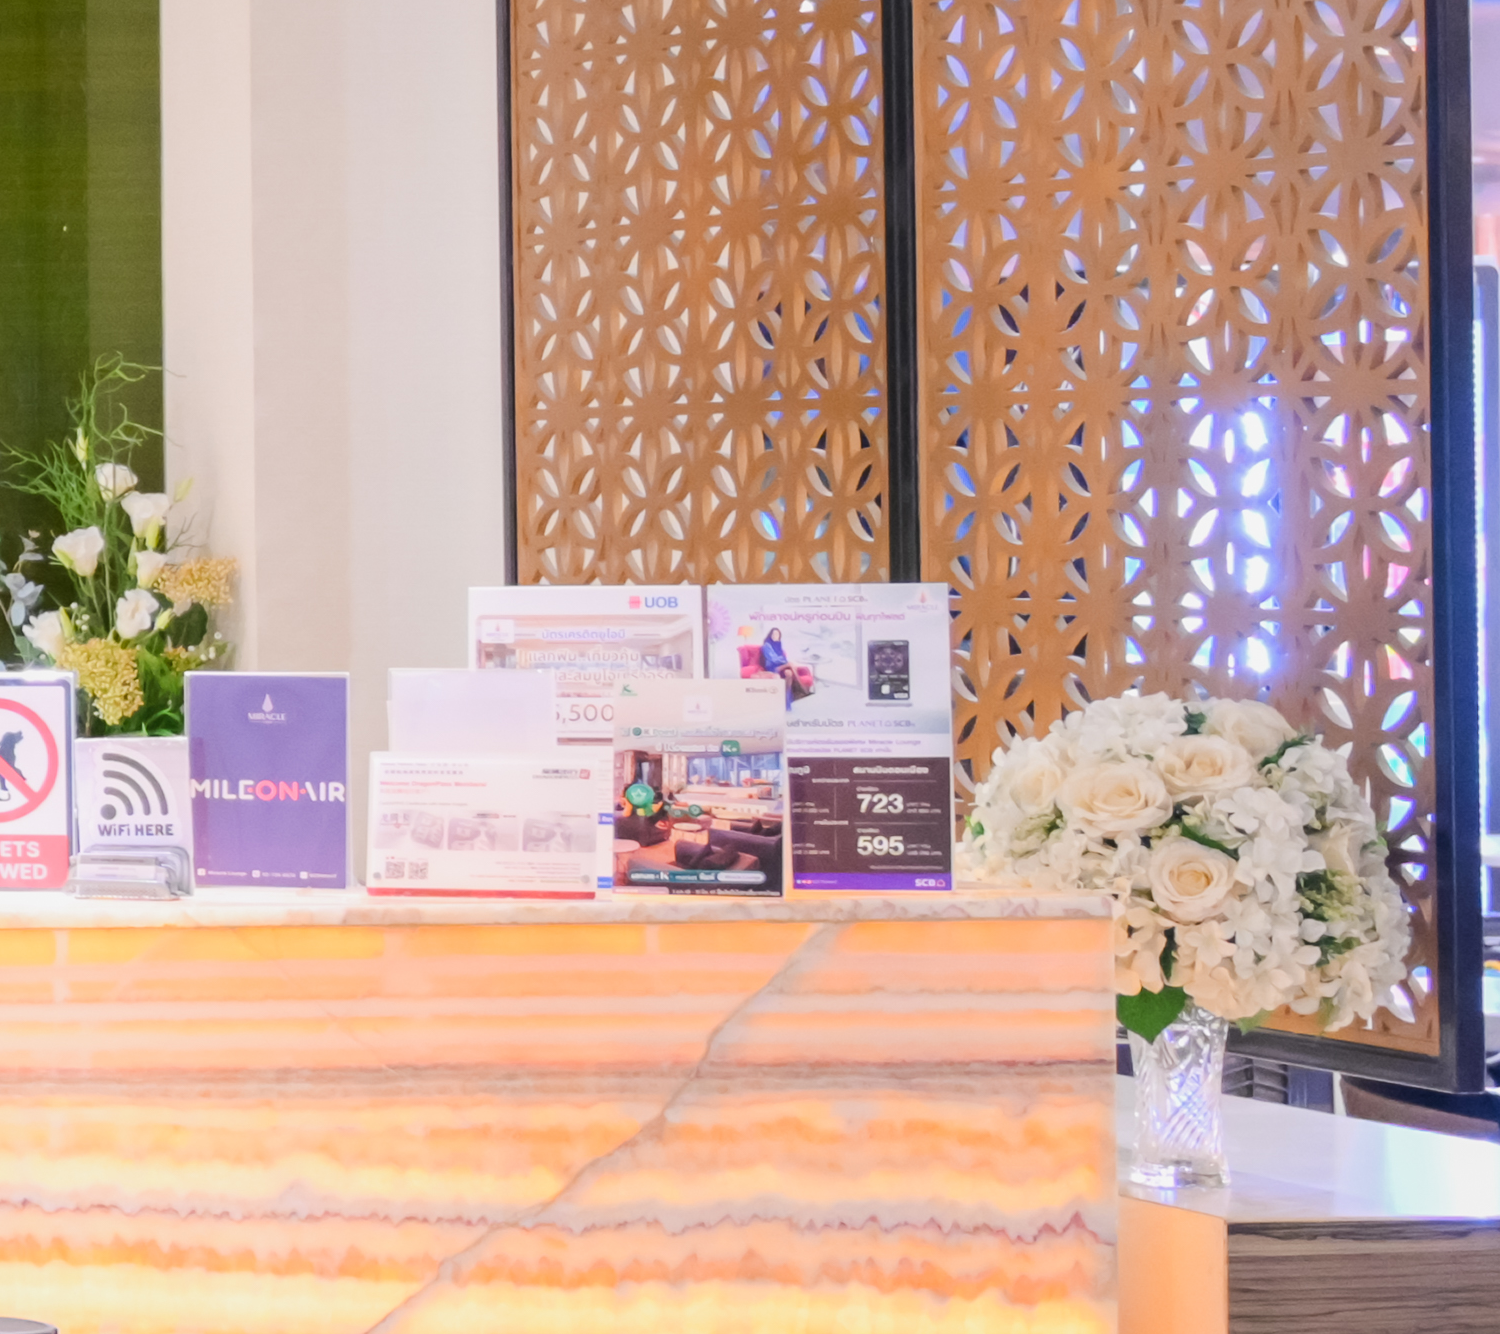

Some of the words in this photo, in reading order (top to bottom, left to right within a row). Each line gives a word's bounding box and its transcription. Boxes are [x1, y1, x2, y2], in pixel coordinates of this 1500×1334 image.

[644, 596, 678, 608] UOB
[856, 793, 904, 814] 723
[134, 824, 174, 837] HERE
[857, 835, 905, 856] 595
[915, 878, 936, 887] SCB
